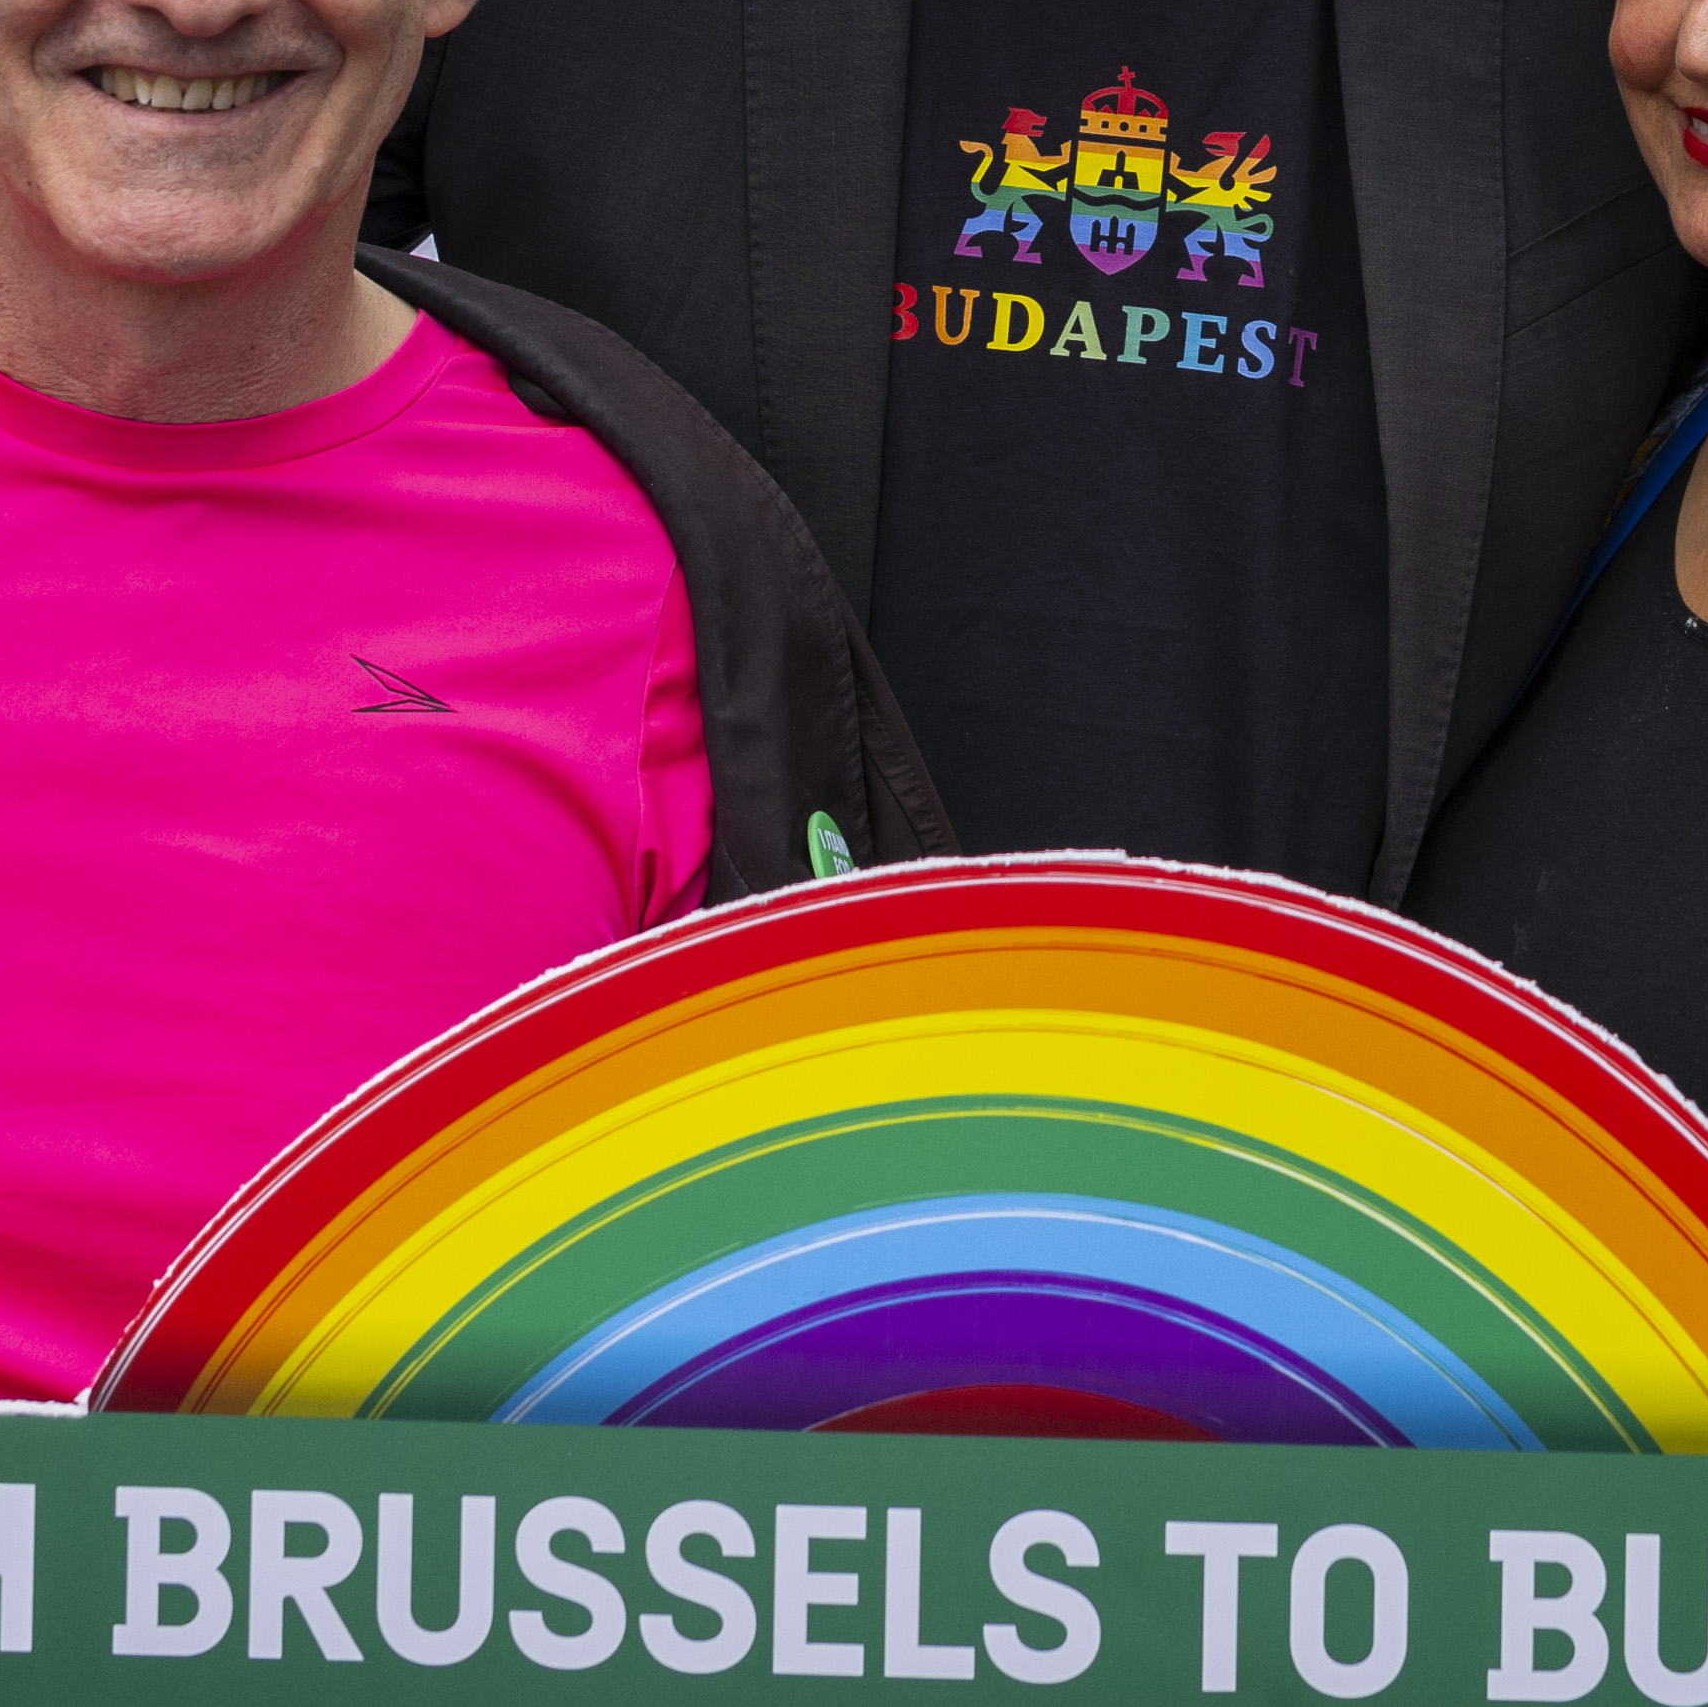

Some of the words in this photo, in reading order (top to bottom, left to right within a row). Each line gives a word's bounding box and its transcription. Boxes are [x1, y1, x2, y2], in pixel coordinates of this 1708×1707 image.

[892, 283, 1318, 388] BUDAPEST
[112, 1485, 1103, 1686] BRUSSELS
[1165, 1521, 1409, 1699] TO
